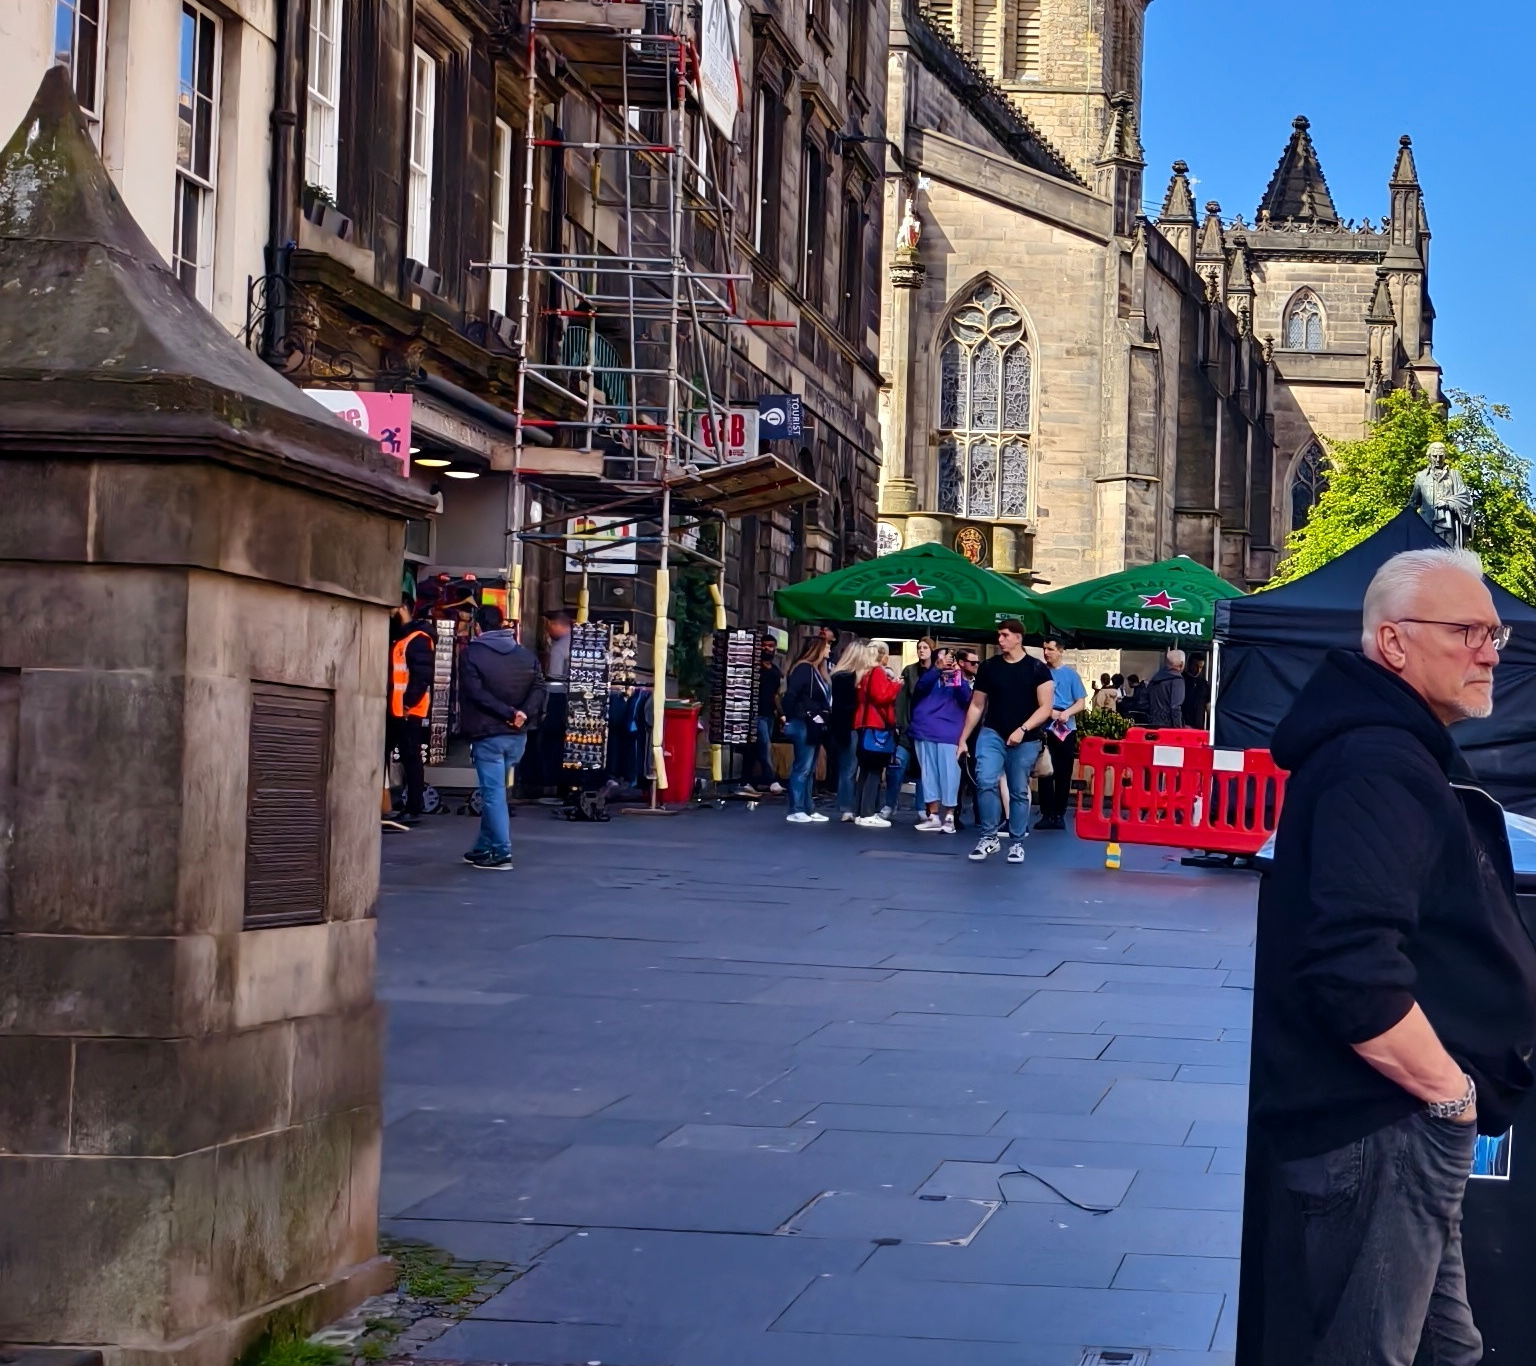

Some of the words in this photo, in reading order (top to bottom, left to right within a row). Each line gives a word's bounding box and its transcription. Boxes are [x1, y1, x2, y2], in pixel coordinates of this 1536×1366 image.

[792, 397, 801, 435] TOURIST
[854, 600, 957, 624] Heineken
[1105, 610, 1205, 636] Heineken
